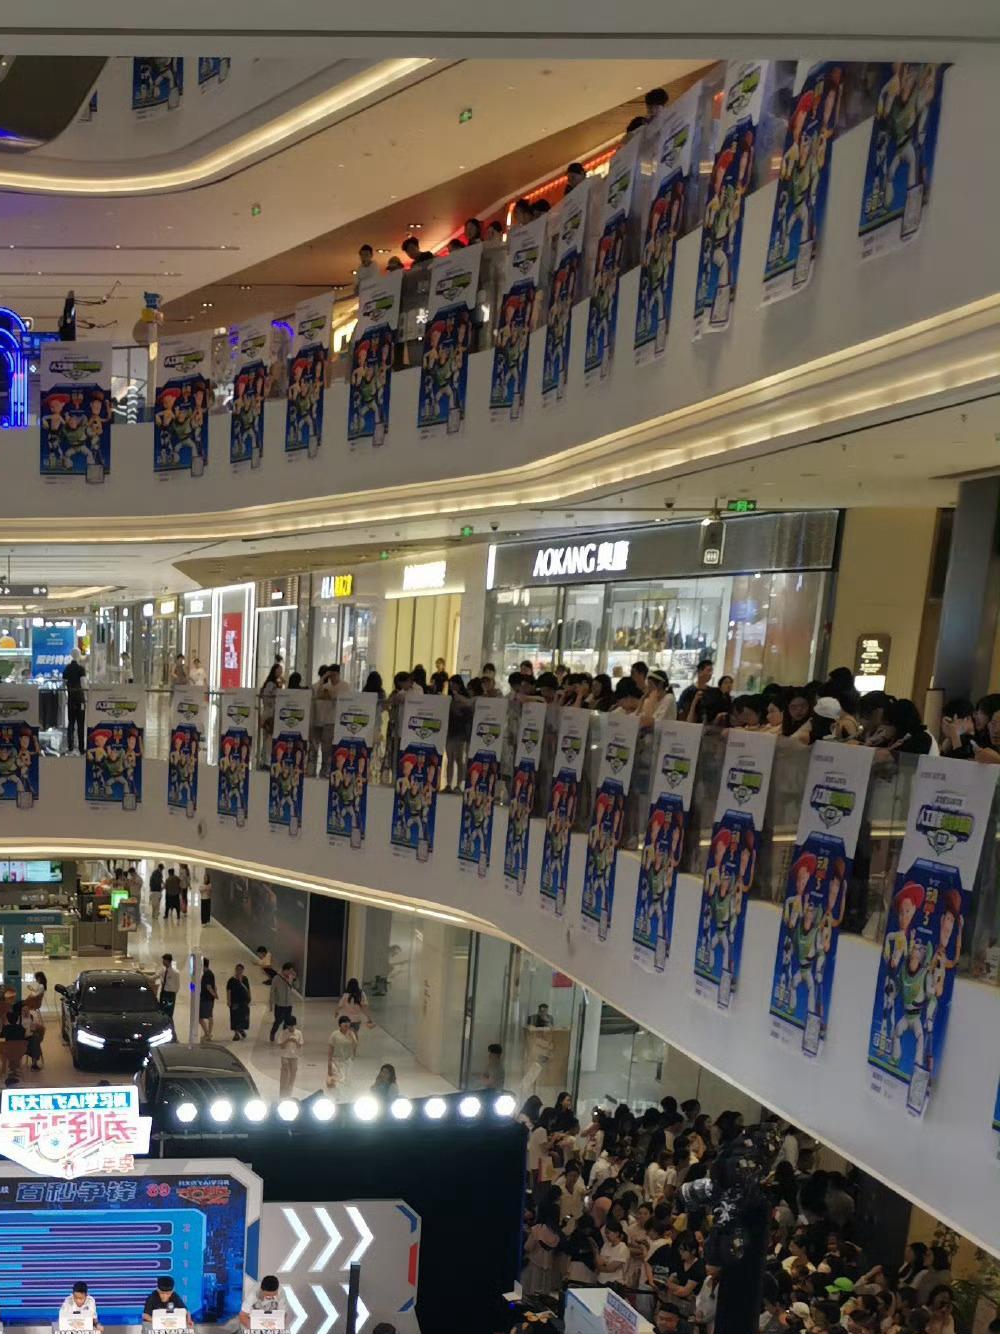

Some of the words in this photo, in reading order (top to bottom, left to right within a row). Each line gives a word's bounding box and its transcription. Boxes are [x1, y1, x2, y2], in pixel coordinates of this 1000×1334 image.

[533, 543, 596, 577] AOKANG
[10, 1091, 127, 1110] 科大讯飞AI学习机
[16, 1180, 137, 1203] 百秒争锋
